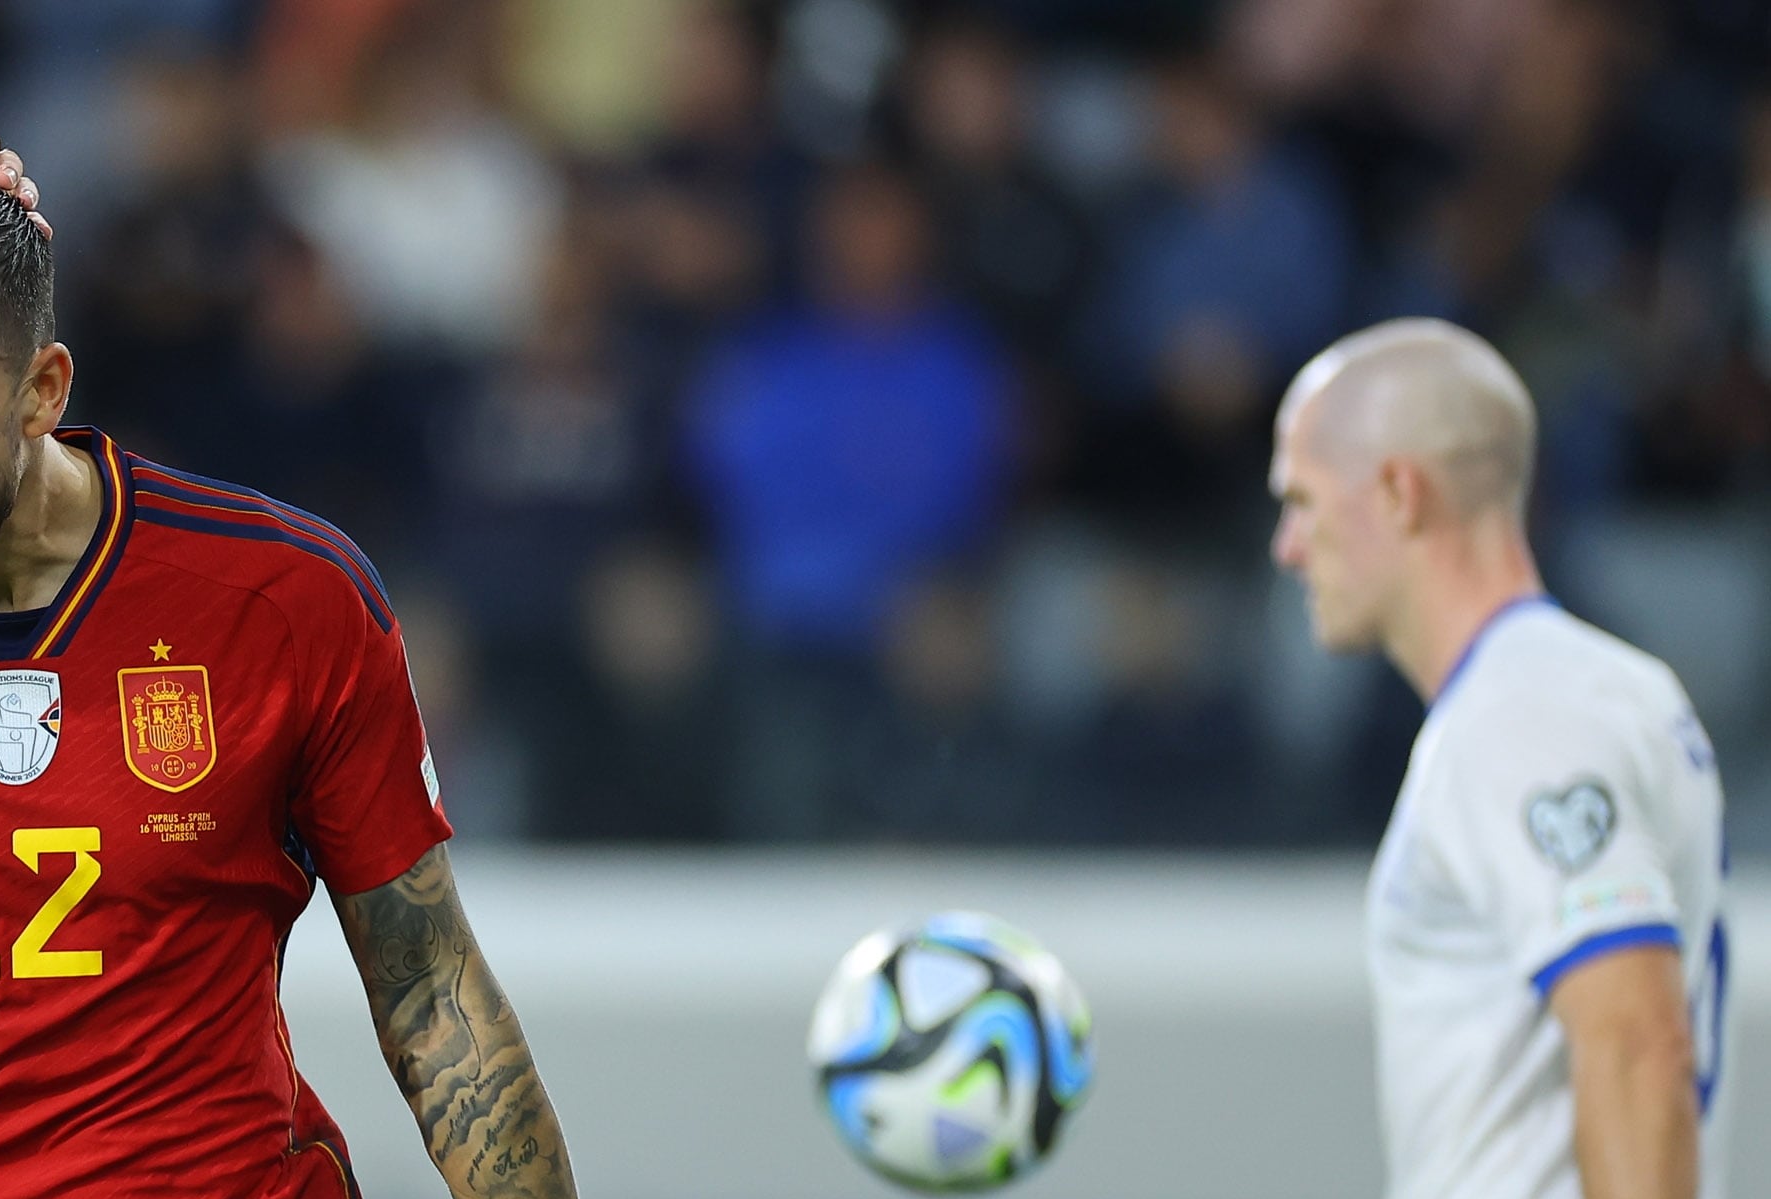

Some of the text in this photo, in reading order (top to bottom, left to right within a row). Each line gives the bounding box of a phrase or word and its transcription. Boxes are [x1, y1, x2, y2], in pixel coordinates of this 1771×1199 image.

[24, 674, 55, 685] LEAGUE
[147, 813, 179, 824] CYPRUS
[187, 811, 211, 822] SPAIN
[139, 821, 217, 834] 16 NOVEMBER 2023
[160, 832, 199, 842] LIMASSOL
